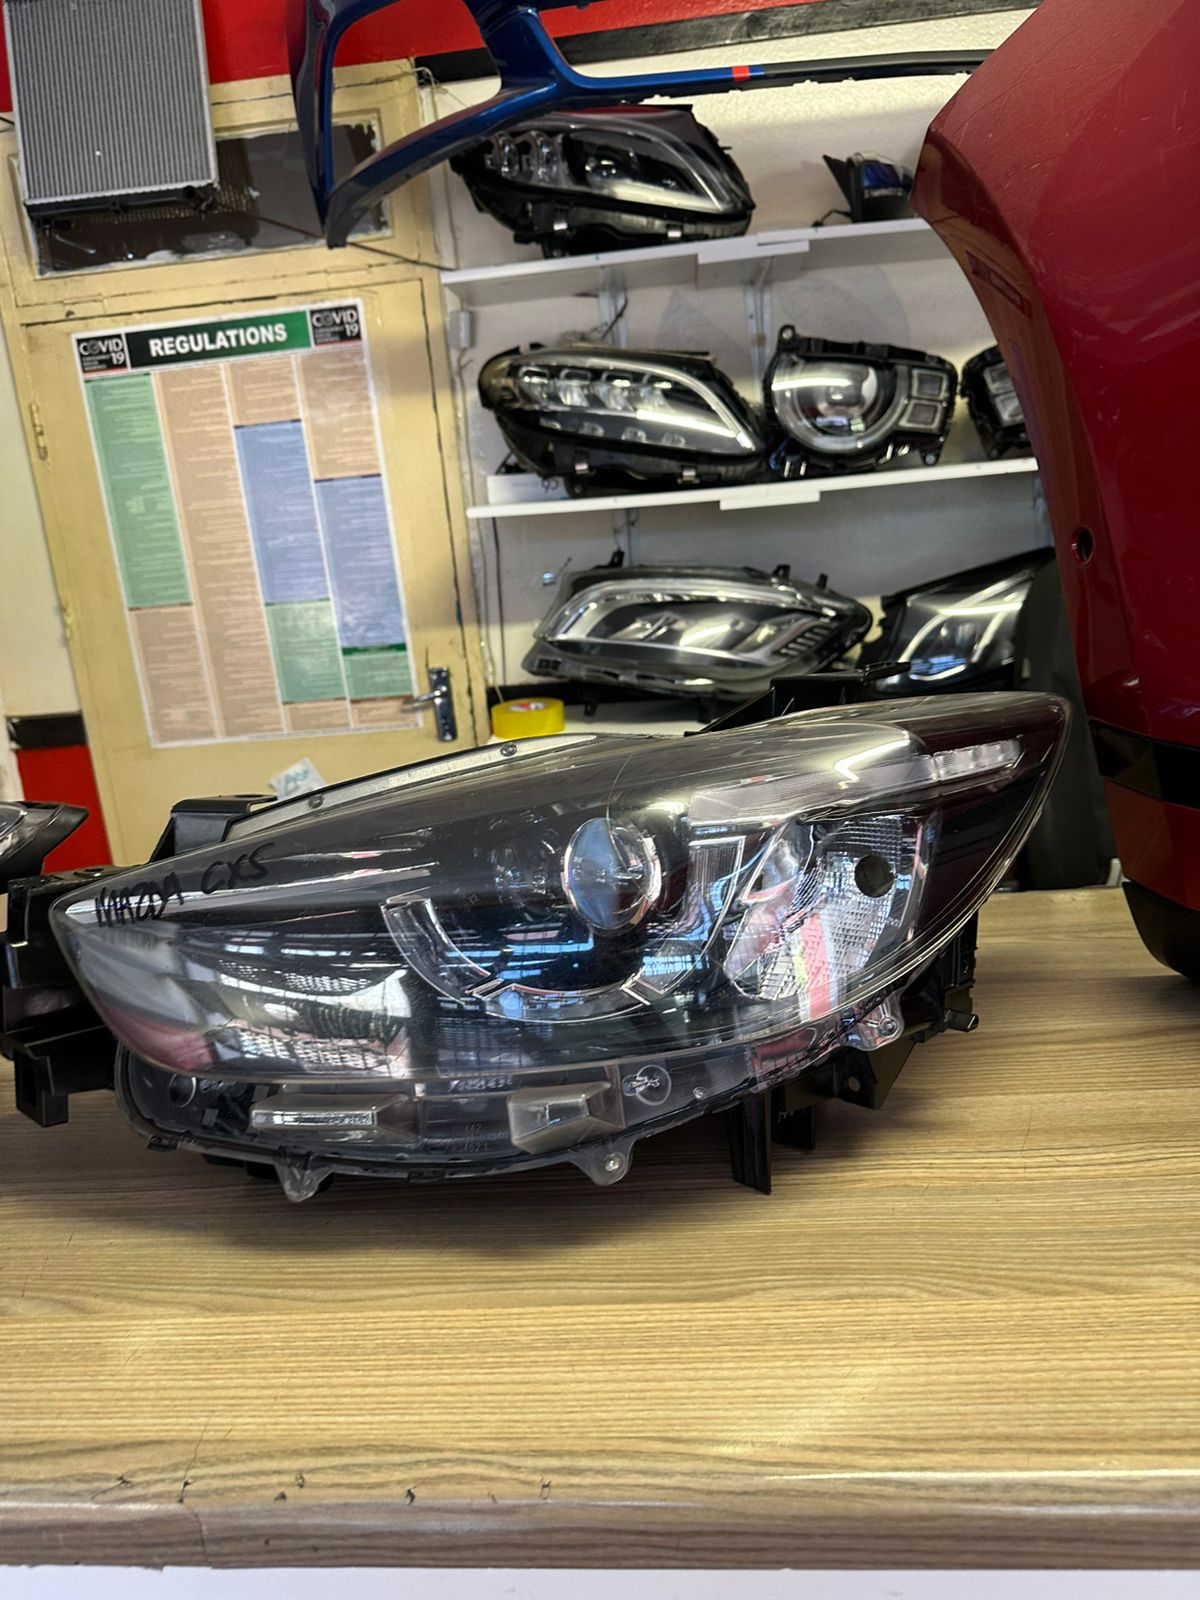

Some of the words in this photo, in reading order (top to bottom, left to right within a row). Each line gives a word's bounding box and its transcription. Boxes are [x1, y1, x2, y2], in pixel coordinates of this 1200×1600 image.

[312, 309, 358, 327] COVID
[344, 323, 360, 337] 19
[80, 338, 123, 356] COVID
[149, 323, 288, 357] REGULATIONS
[111, 351, 126, 365] 19
